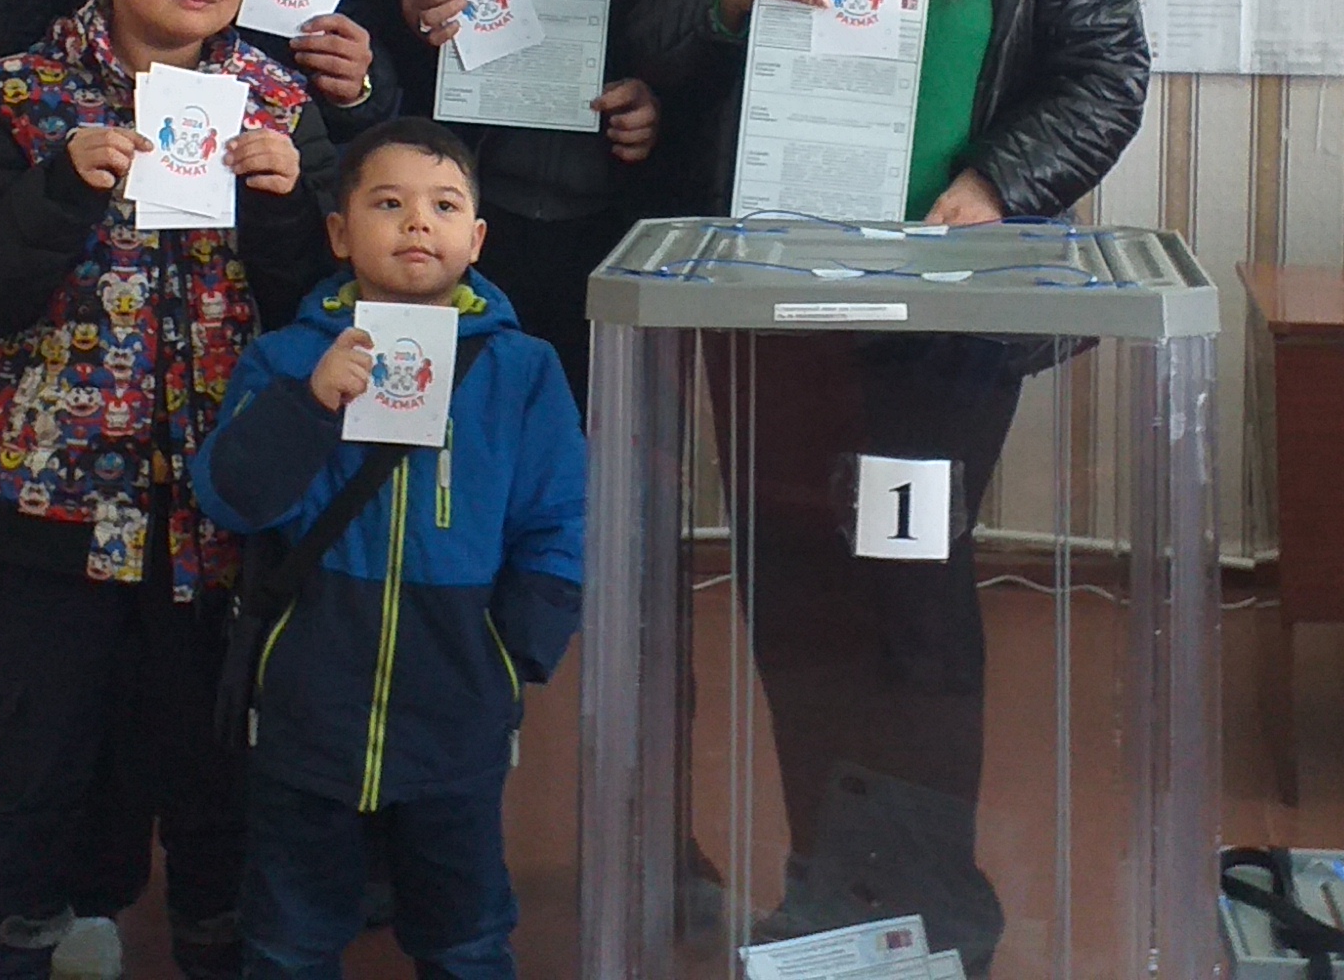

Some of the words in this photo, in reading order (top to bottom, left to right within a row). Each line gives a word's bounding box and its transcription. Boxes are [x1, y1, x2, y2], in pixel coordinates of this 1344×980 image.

[474, 11, 514, 31] РАХМАТ
[160, 155, 207, 176] РАХМАТ
[887, 481, 918, 541] 1
